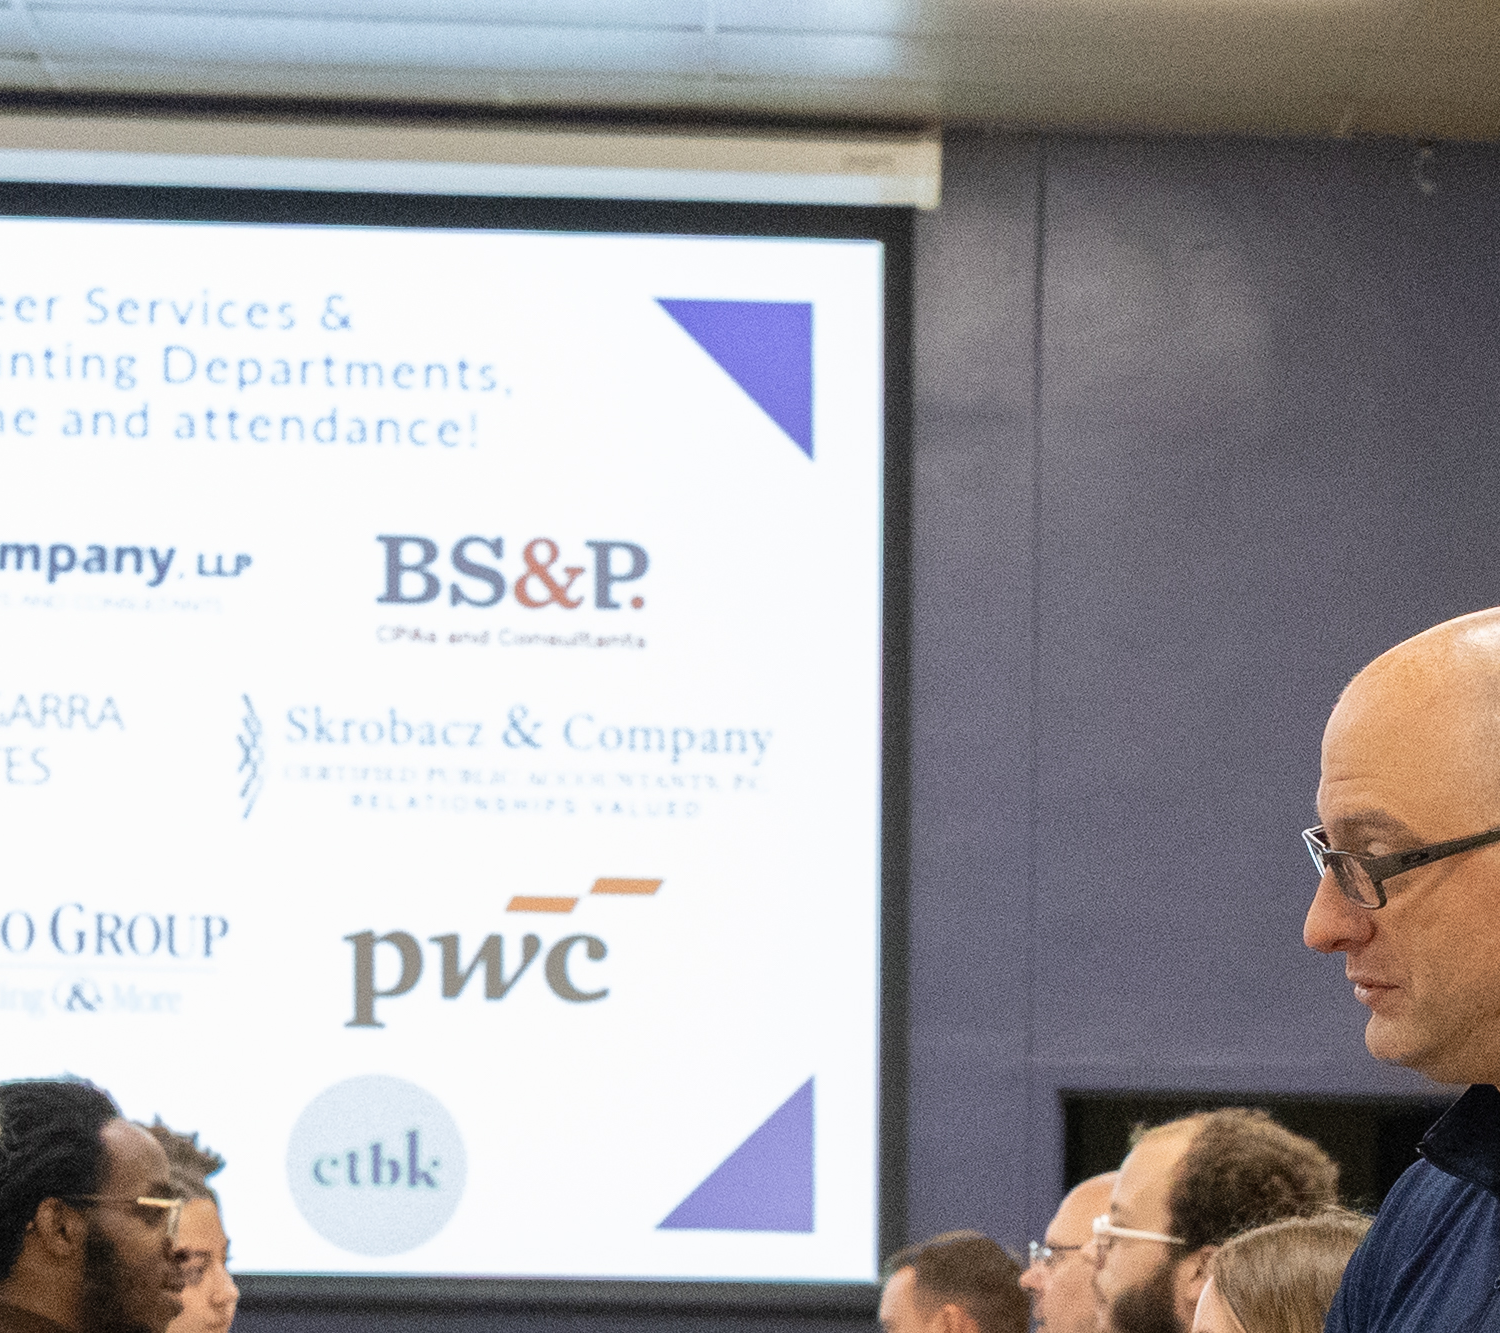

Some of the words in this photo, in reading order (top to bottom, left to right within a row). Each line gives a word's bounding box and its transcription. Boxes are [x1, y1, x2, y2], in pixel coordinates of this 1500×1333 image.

[86, 287, 297, 331] Services
[320, 294, 353, 331] &
[163, 345, 513, 397] Departments,
[61, 403, 149, 439] and
[174, 405, 478, 449] attendance!
[197, 553, 253, 578] LLP
[285, 704, 485, 750] Skrobacz
[501, 703, 543, 750] &
[562, 710, 774, 767] Company
[48, 902, 230, 958] GROUP
[343, 928, 611, 1029] pwc
[311, 1129, 440, 1191] ctbk
